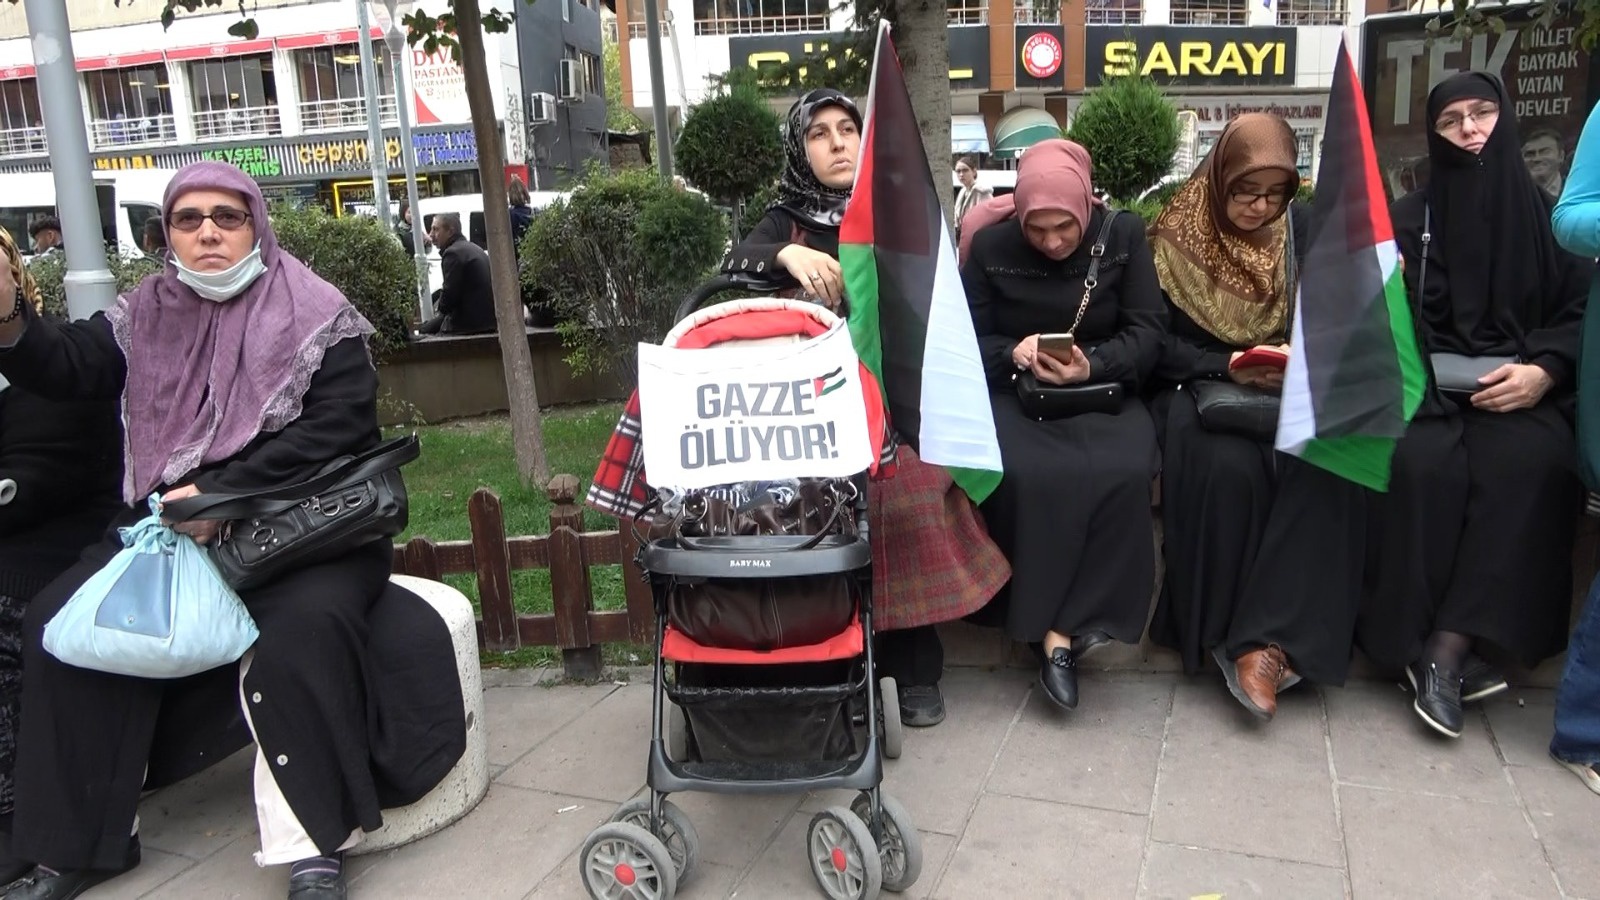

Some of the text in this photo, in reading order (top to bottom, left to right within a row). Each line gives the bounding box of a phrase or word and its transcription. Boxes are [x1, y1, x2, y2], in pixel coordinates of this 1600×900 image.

[1104, 41, 1286, 76] SARAYI
[1518, 50, 1579, 72] BAYRAK
[1517, 75, 1564, 95] VATAN
[1515, 97, 1572, 117] DEVLET
[299, 139, 401, 165] cepshp
[697, 378, 815, 420] GAZZE
[680, 420, 839, 469] ÖLÜYOR!
[730, 559, 771, 567] BABY MAX
